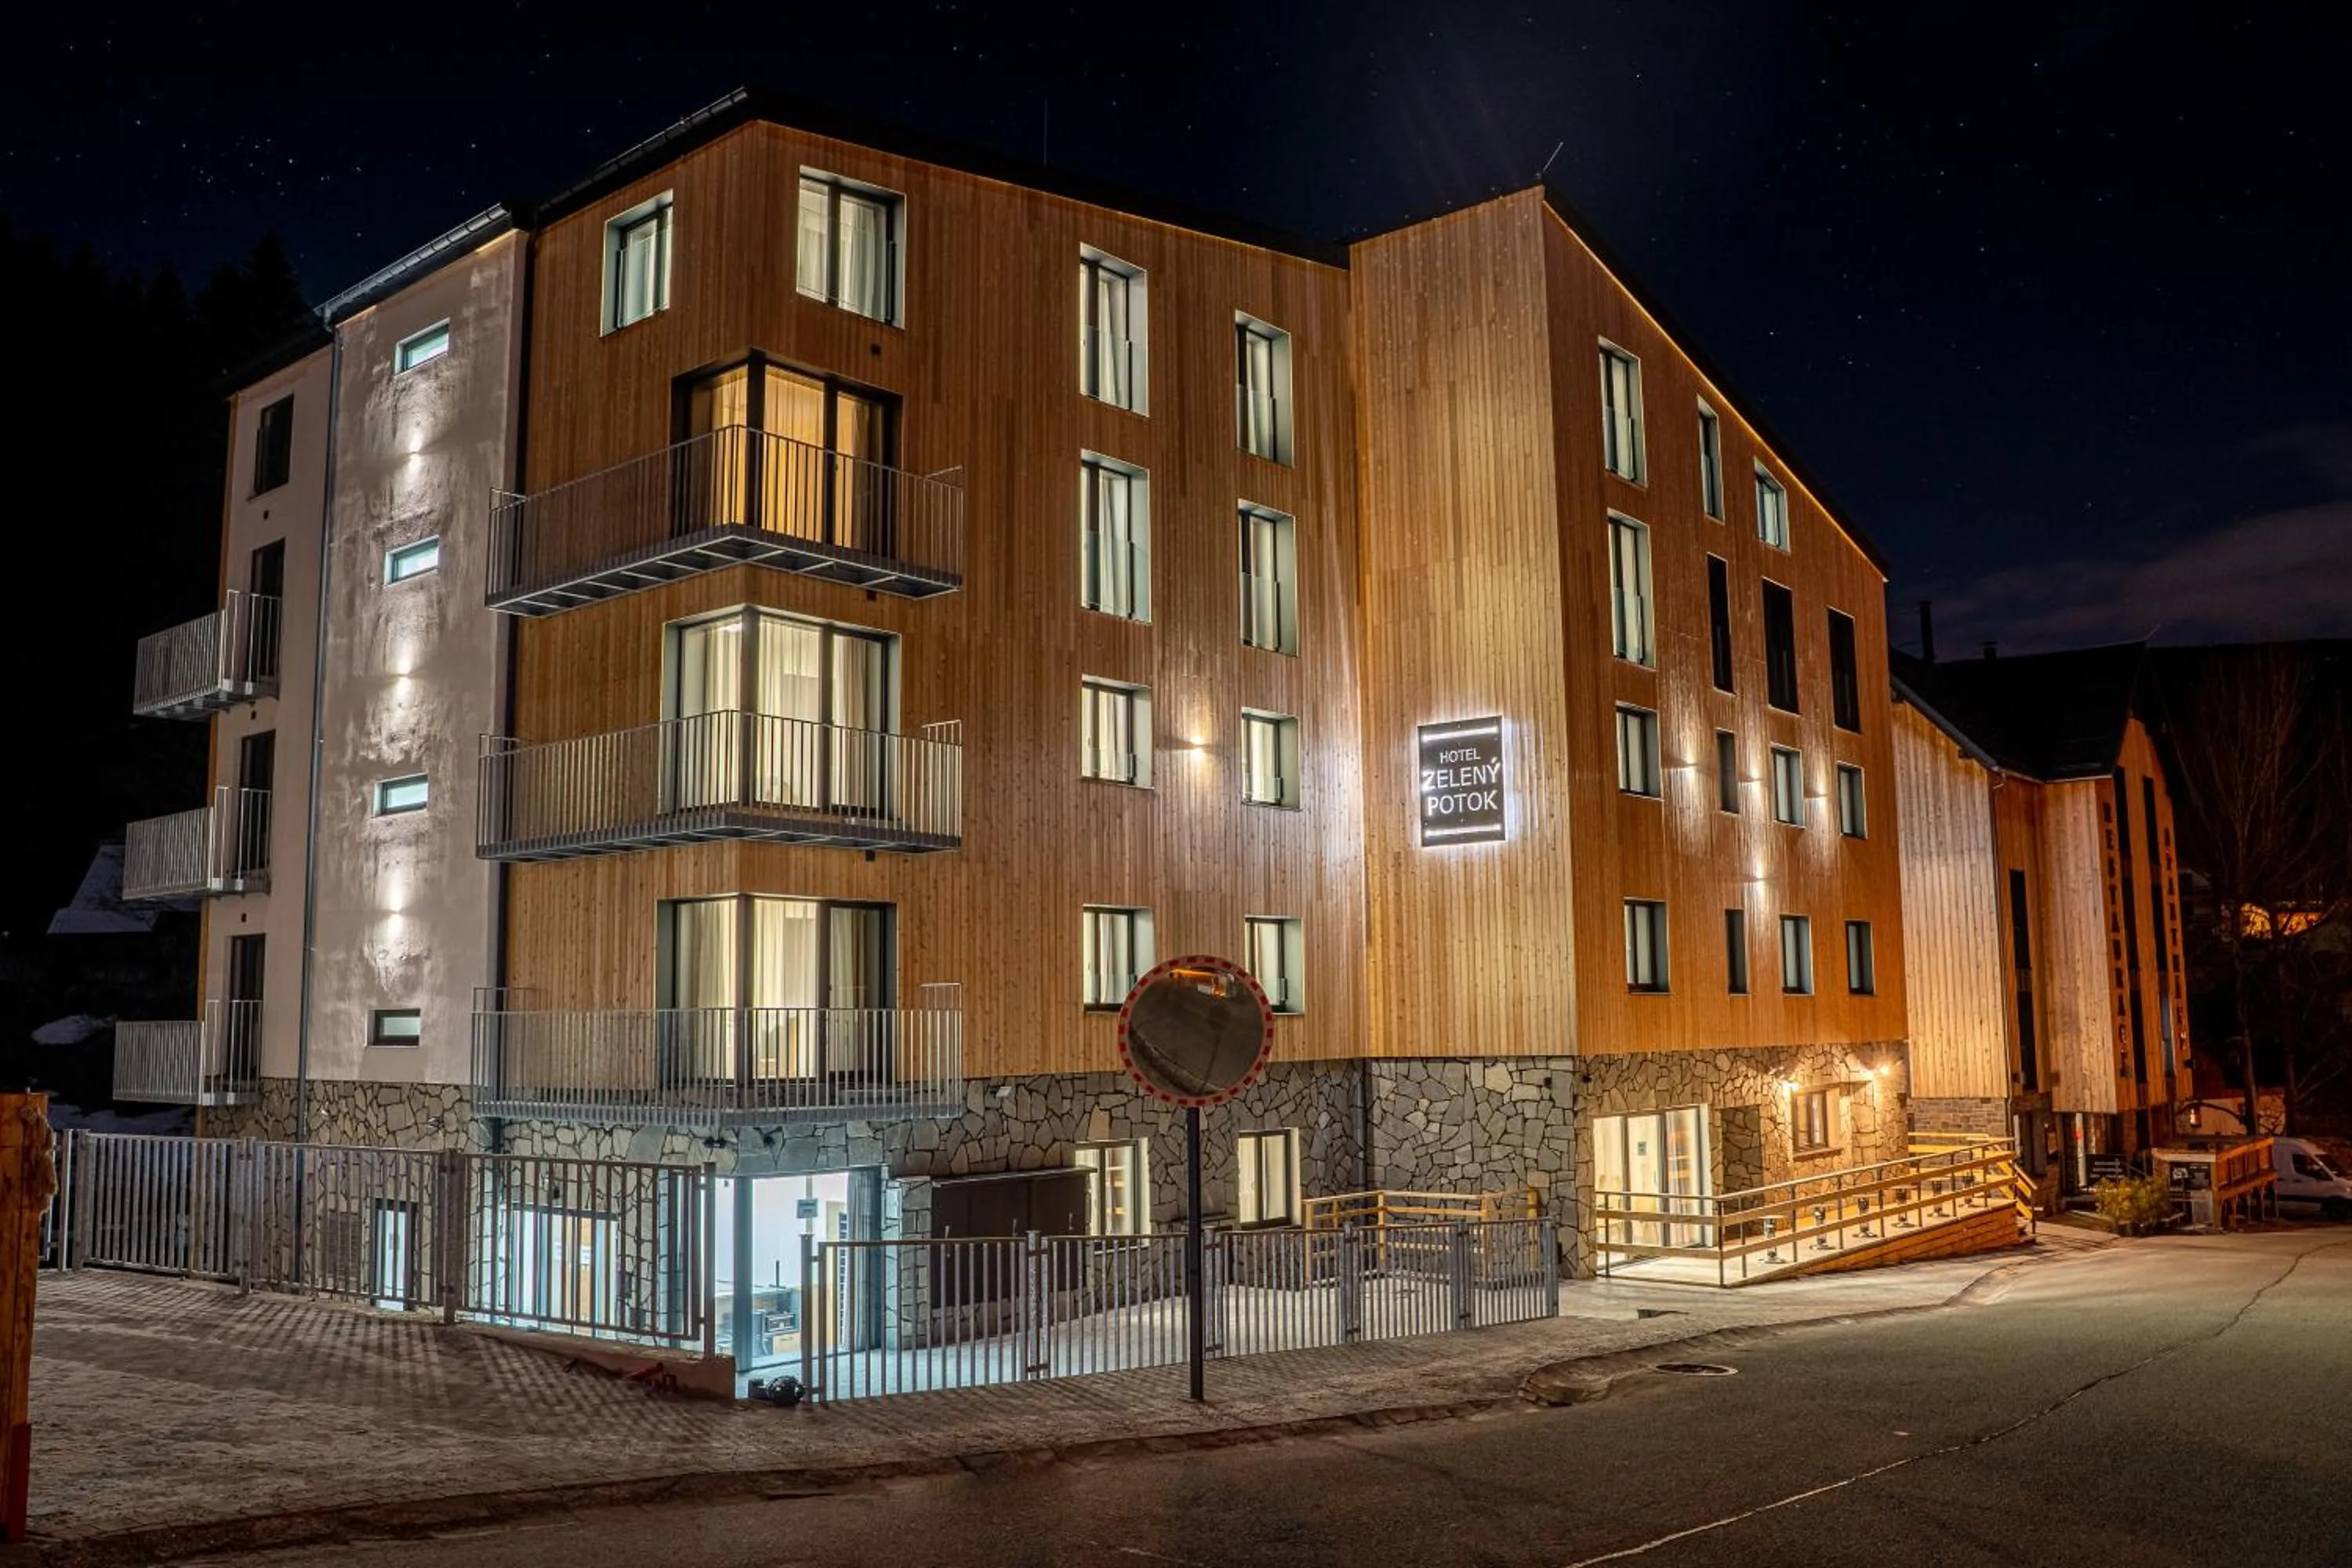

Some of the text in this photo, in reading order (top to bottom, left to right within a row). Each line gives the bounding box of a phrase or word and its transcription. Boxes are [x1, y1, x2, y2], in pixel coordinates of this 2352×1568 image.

[1440, 748, 1481, 764] HOTEL
[1421, 757, 1501, 793] ZELENÝ
[1428, 789, 1498, 816] POTOK
